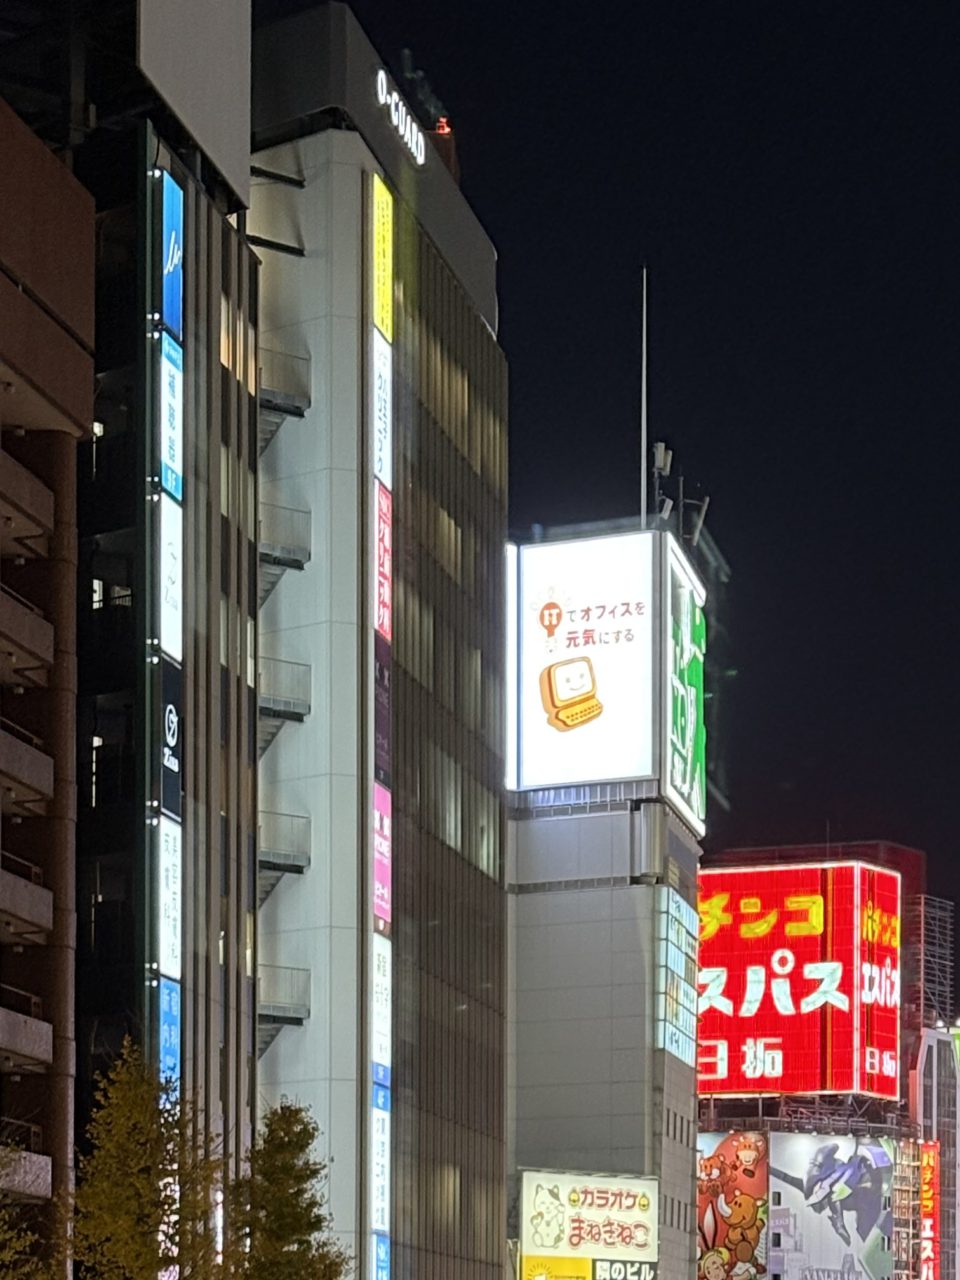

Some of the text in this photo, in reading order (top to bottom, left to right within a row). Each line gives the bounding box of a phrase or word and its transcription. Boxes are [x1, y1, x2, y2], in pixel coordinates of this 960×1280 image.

[566, 628, 635, 648] 元気にする
[580, 1188, 639, 1211] カラオケ
[569, 1215, 651, 1248] まねきねこ
